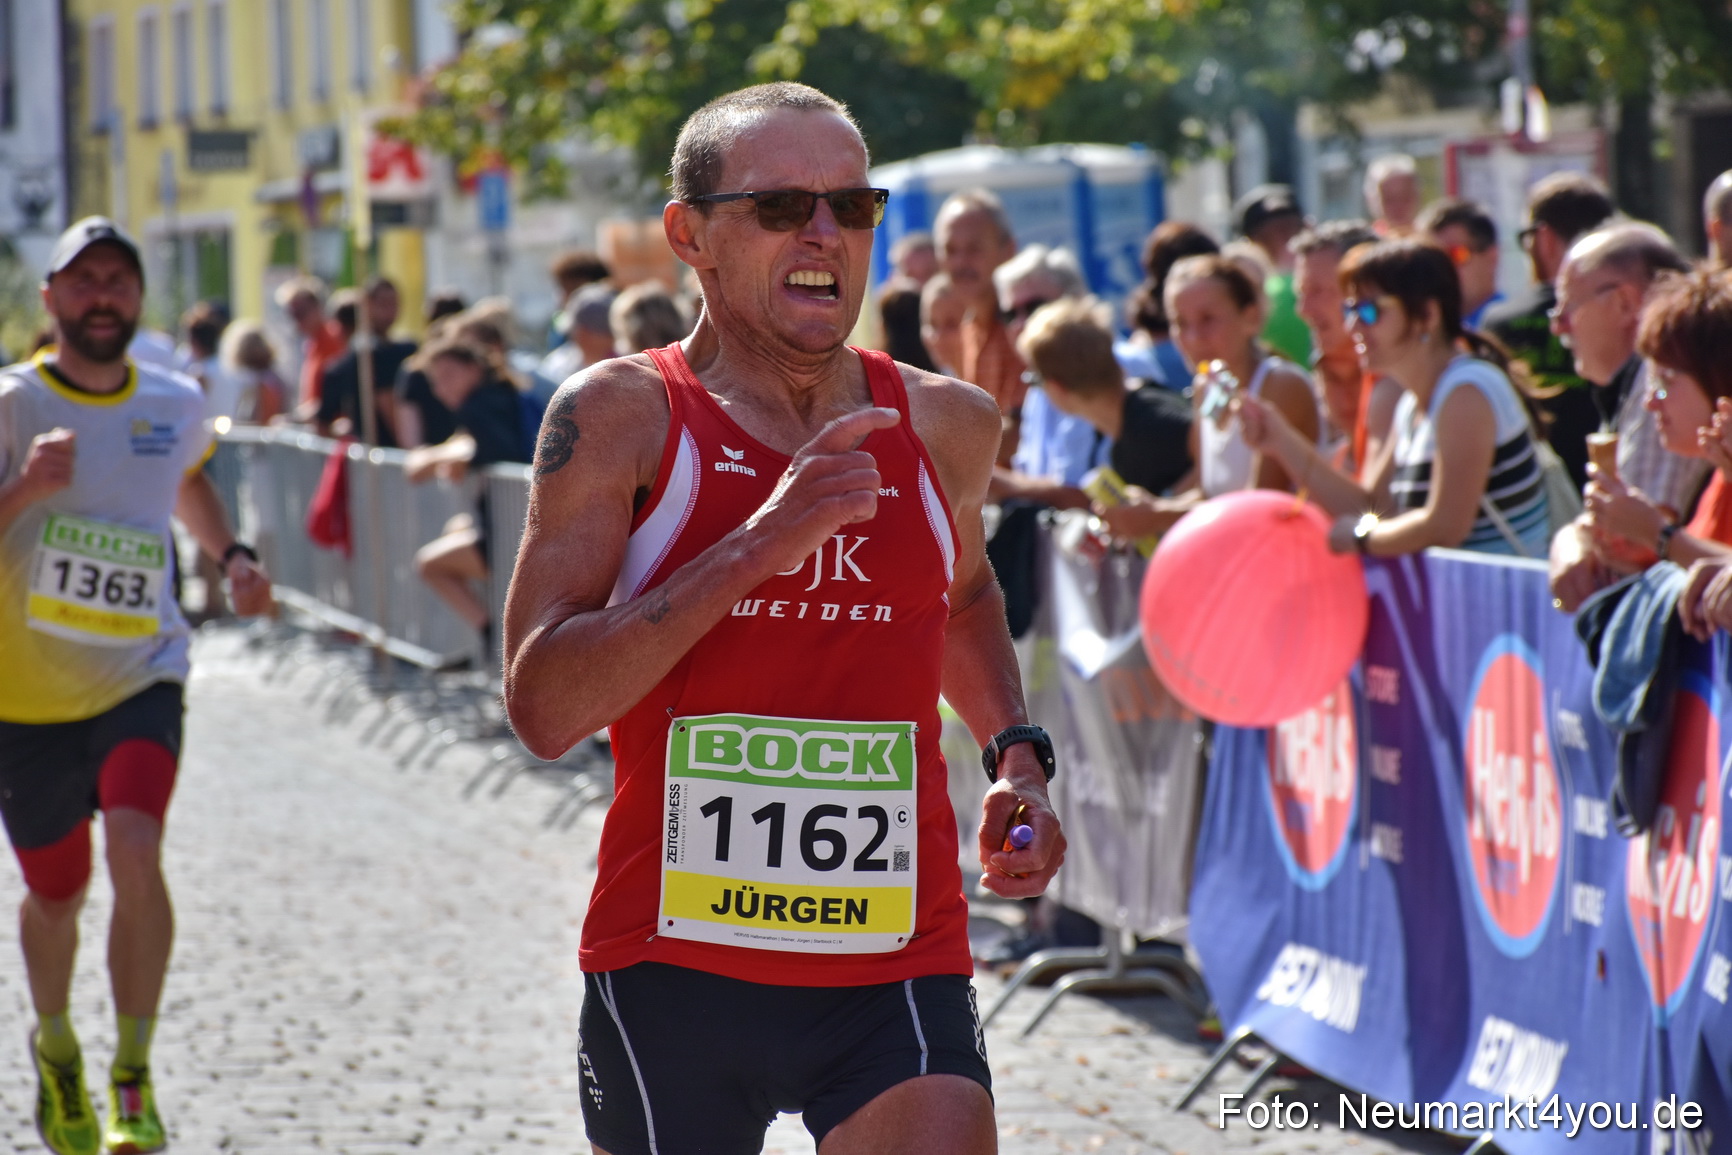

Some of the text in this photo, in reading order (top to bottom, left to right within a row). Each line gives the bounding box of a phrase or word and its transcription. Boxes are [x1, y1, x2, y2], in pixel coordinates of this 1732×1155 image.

[715, 461, 757, 477] erima
[55, 521, 158, 562] BOCK
[776, 534, 871, 591] JK
[53, 558, 147, 609] 1363
[688, 724, 900, 782] BOCK
[700, 796, 889, 872] 1162
[897, 810, 907, 823] C
[711, 885, 869, 925] JÜRGEN
